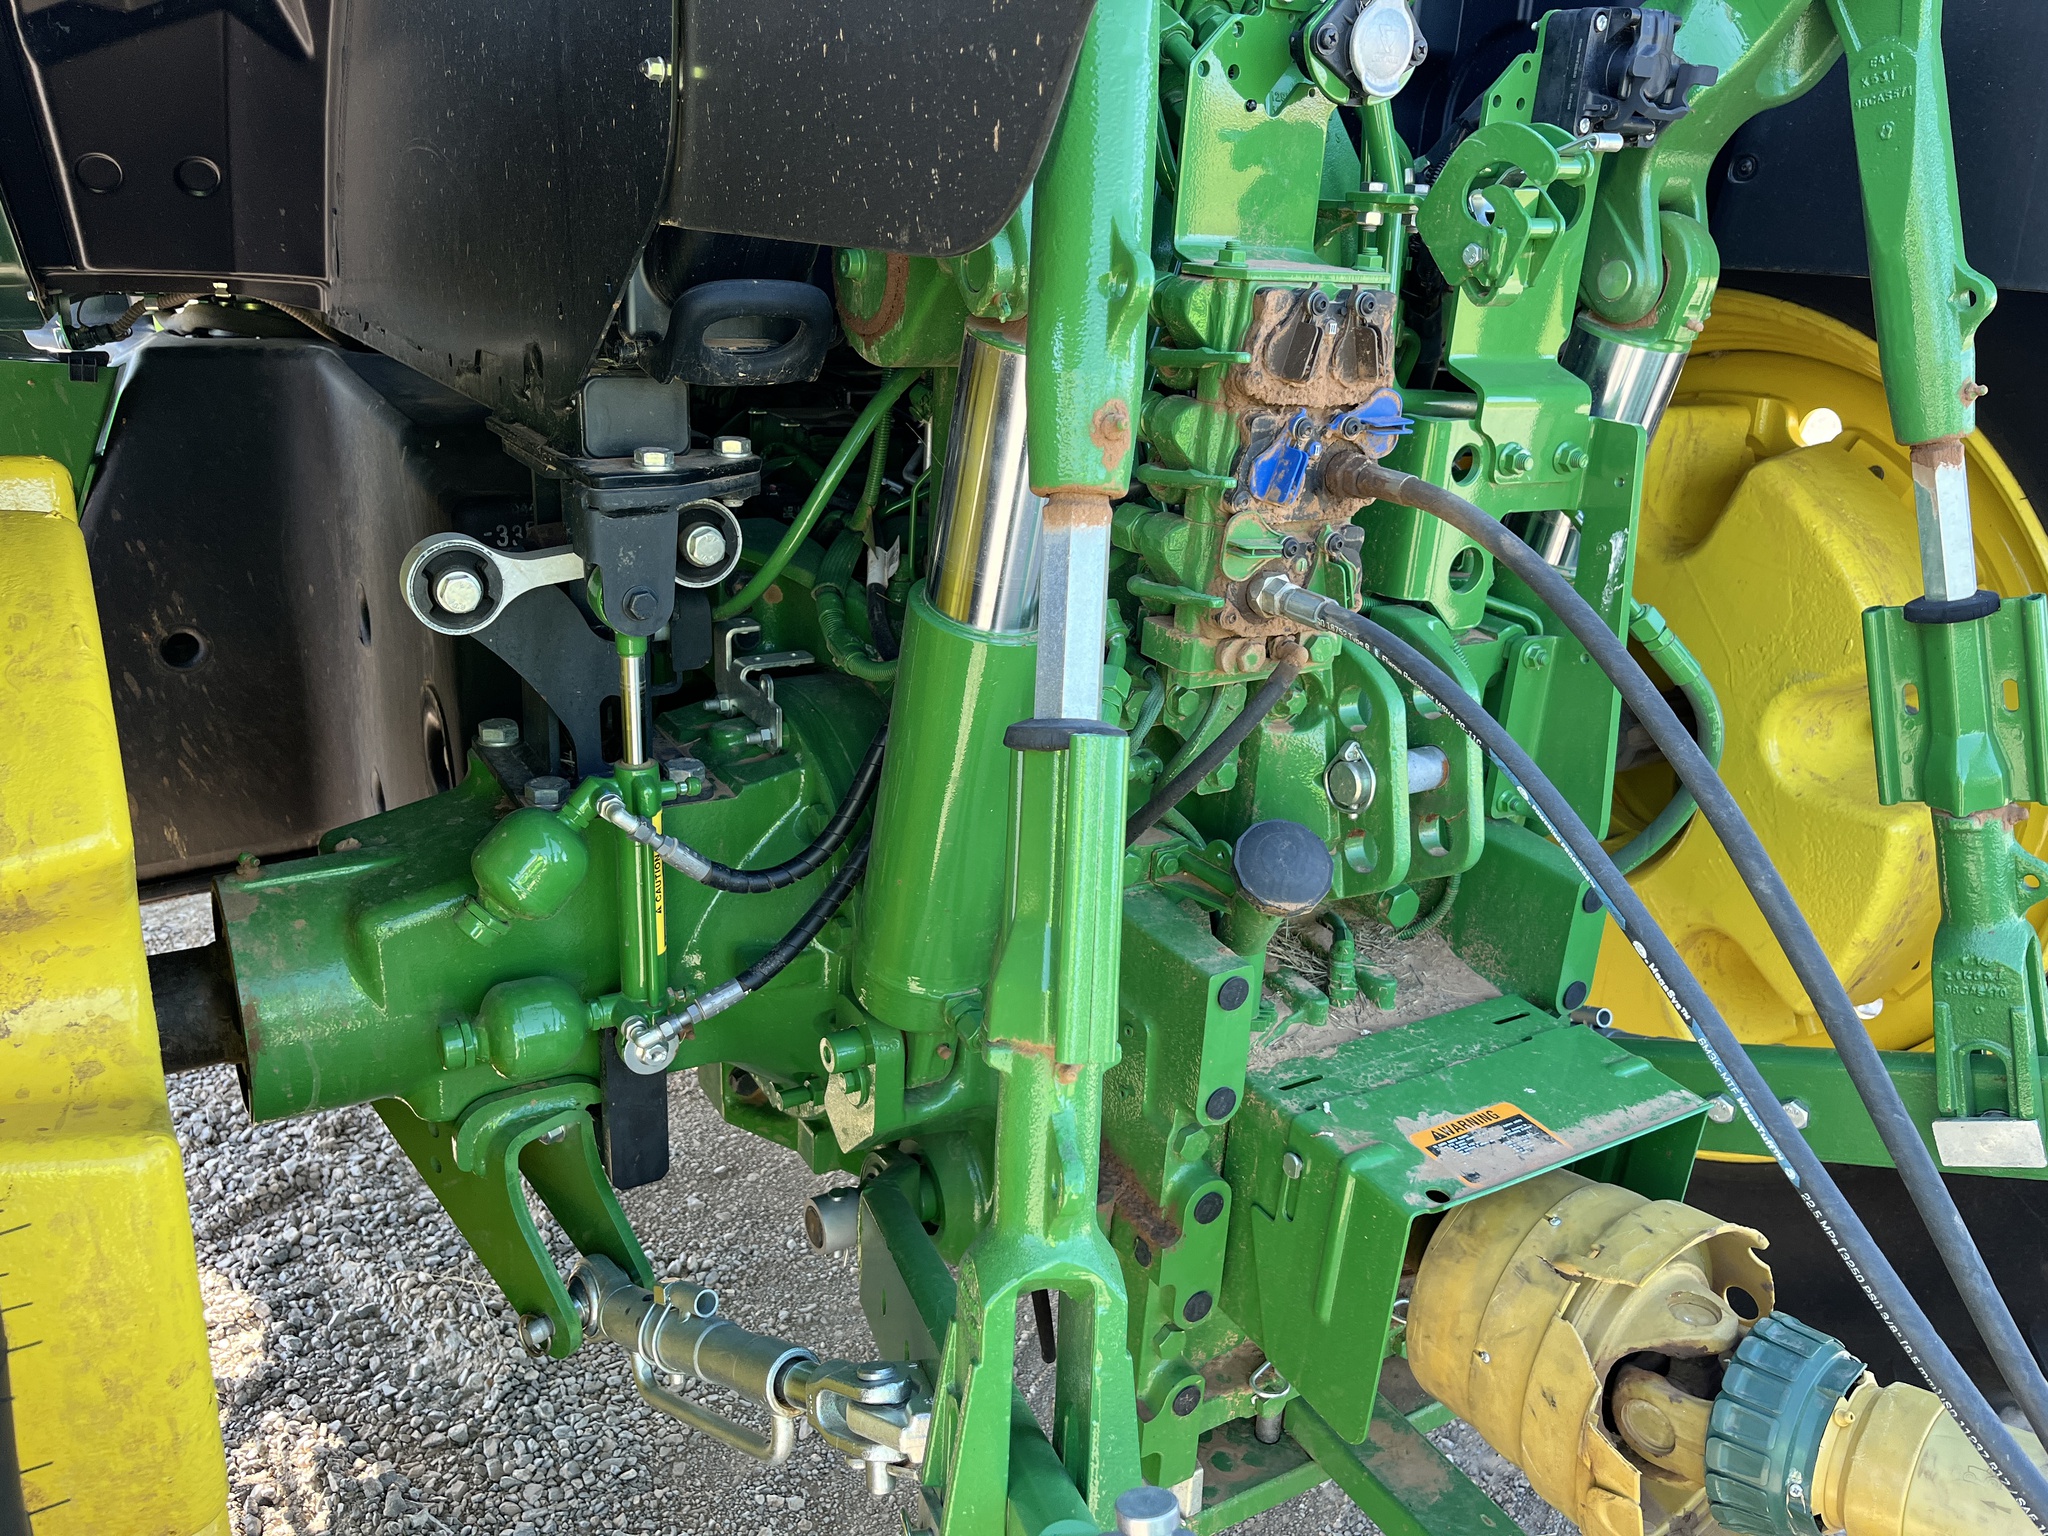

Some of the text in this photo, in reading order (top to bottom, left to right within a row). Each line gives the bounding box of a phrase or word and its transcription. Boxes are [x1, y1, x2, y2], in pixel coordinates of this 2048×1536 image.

[1531, 804, 1561, 843] POWERING
[1697, 1037, 1740, 1095] 6M3K-MTF
[1437, 1110, 1501, 1136] WARNING
[1800, 1192, 1823, 1219] 22.5
[1819, 1220, 1839, 1246] MPa
[1941, 1398, 1958, 1419] ISO
